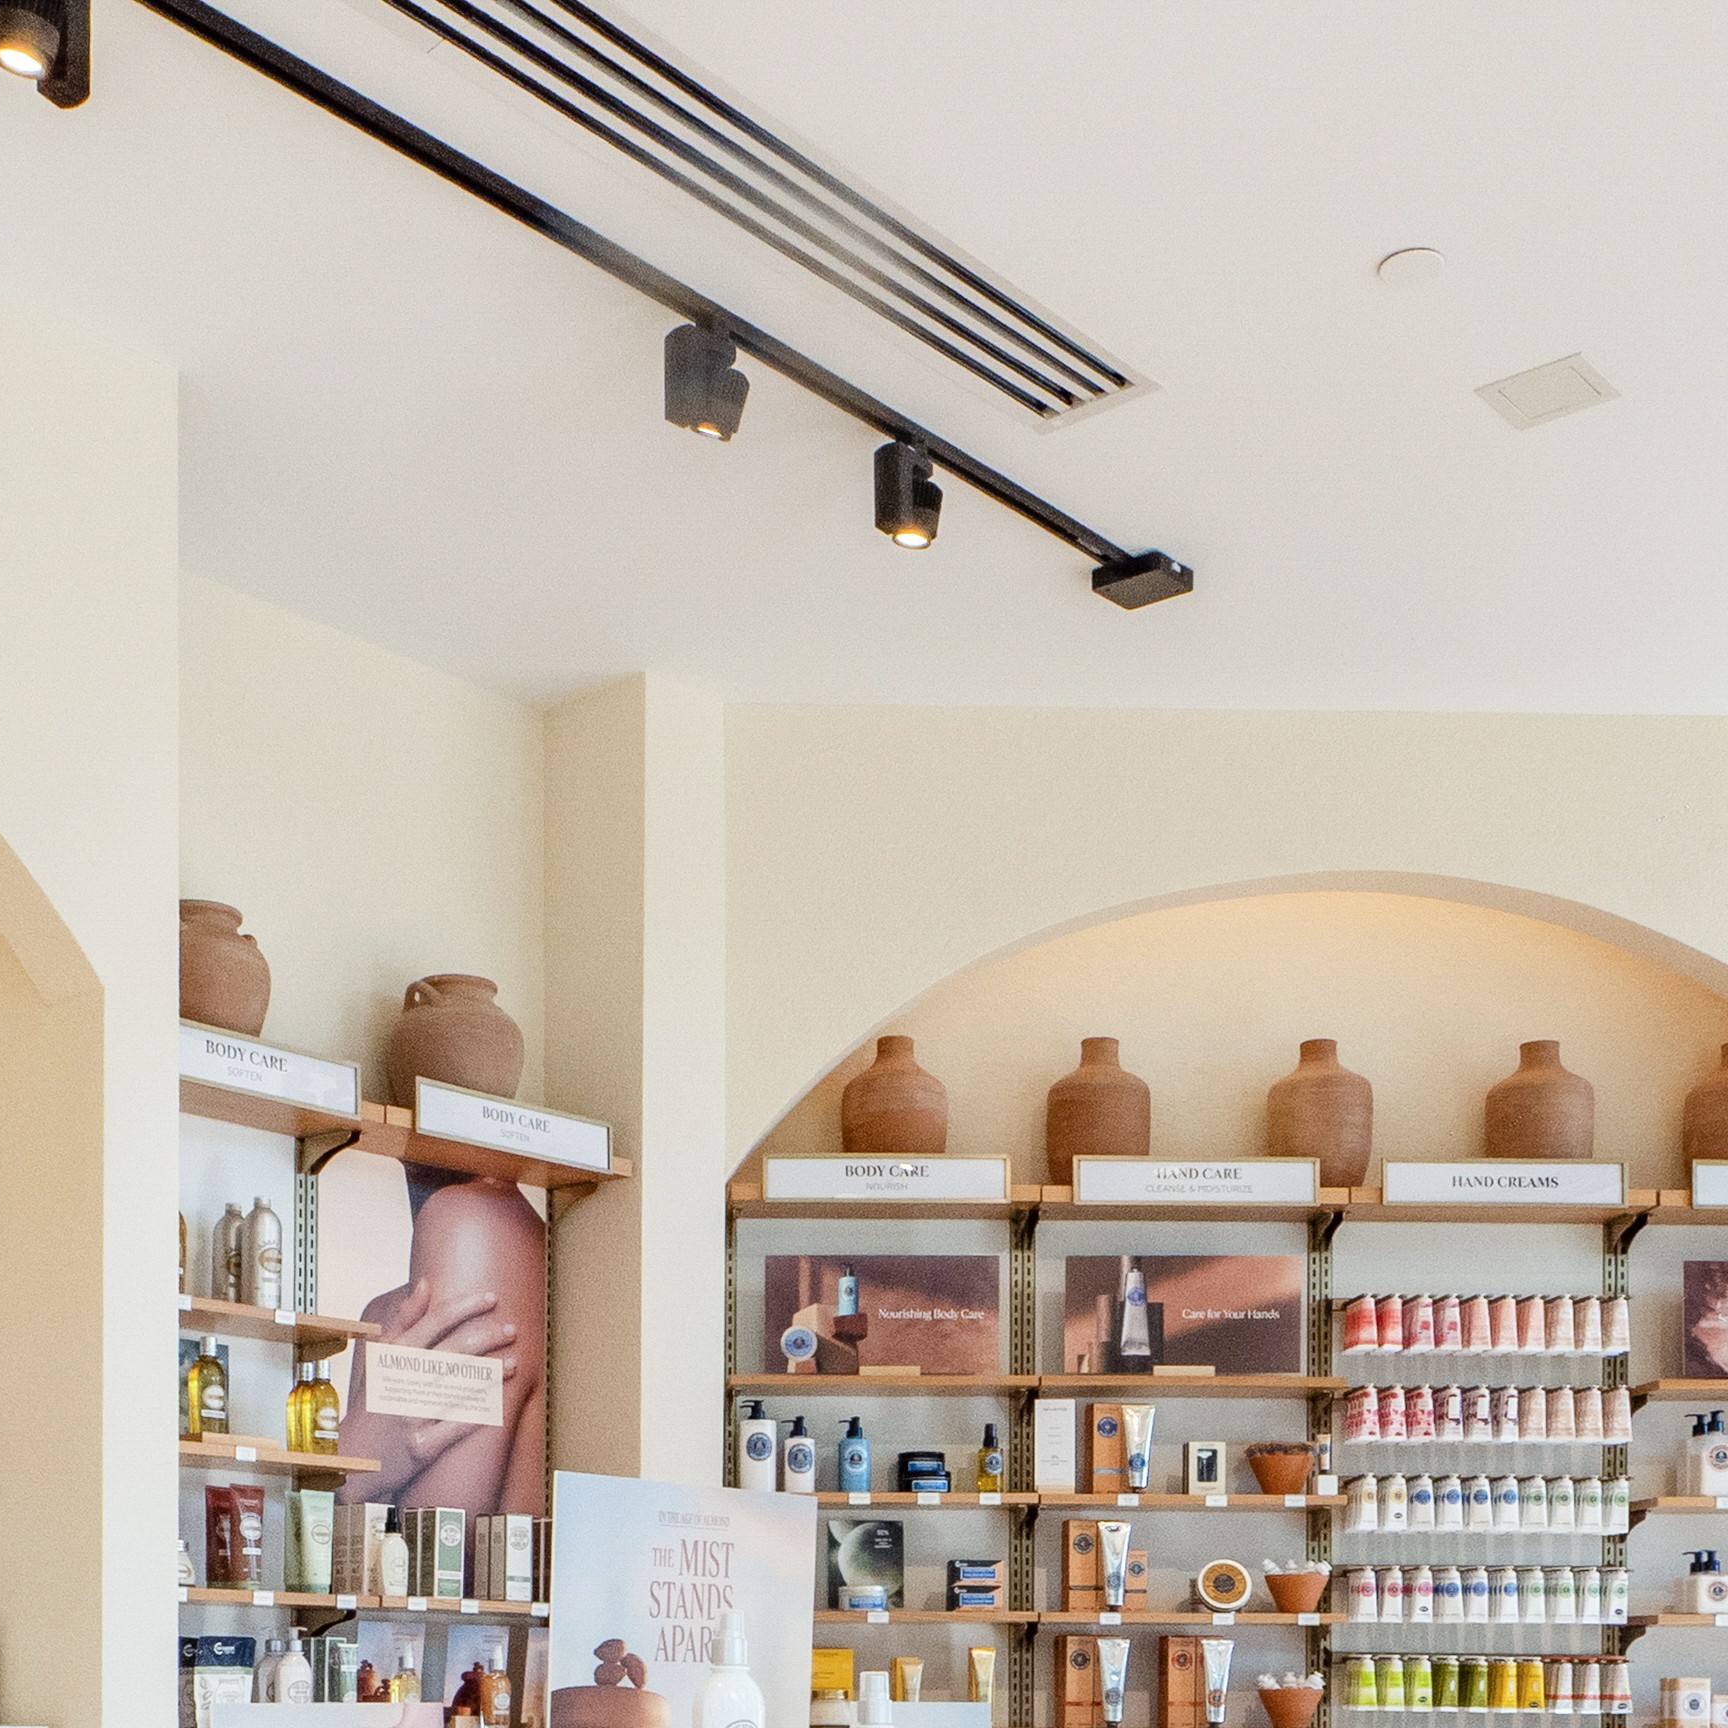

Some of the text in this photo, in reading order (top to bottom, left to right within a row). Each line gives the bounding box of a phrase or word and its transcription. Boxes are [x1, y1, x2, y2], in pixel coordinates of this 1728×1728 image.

[205, 1040, 288, 1073] BODY CARE
[227, 1067, 263, 1082] SOFTEN
[482, 1106, 551, 1134] BODY CARE
[500, 1129, 530, 1143] SOFTEN
[844, 1164, 929, 1178] BODY CARE
[1156, 1167, 1242, 1180] HAND CARE
[865, 1182, 908, 1191] NOURISH
[1145, 1184, 1186, 1194] CLEANSE
[1451, 1176, 1559, 1189] HAND CREAMS
[878, 1308, 984, 1322] Nourishing Body Care
[1182, 1309, 1280, 1320] Care for Your Hands
[377, 1354, 493, 1381] ALMOND LIKE NO OTHER
[652, 1539, 735, 1579] THE MIST
[649, 1581, 734, 1620] STANDS
[654, 1625, 715, 1664] APAR
